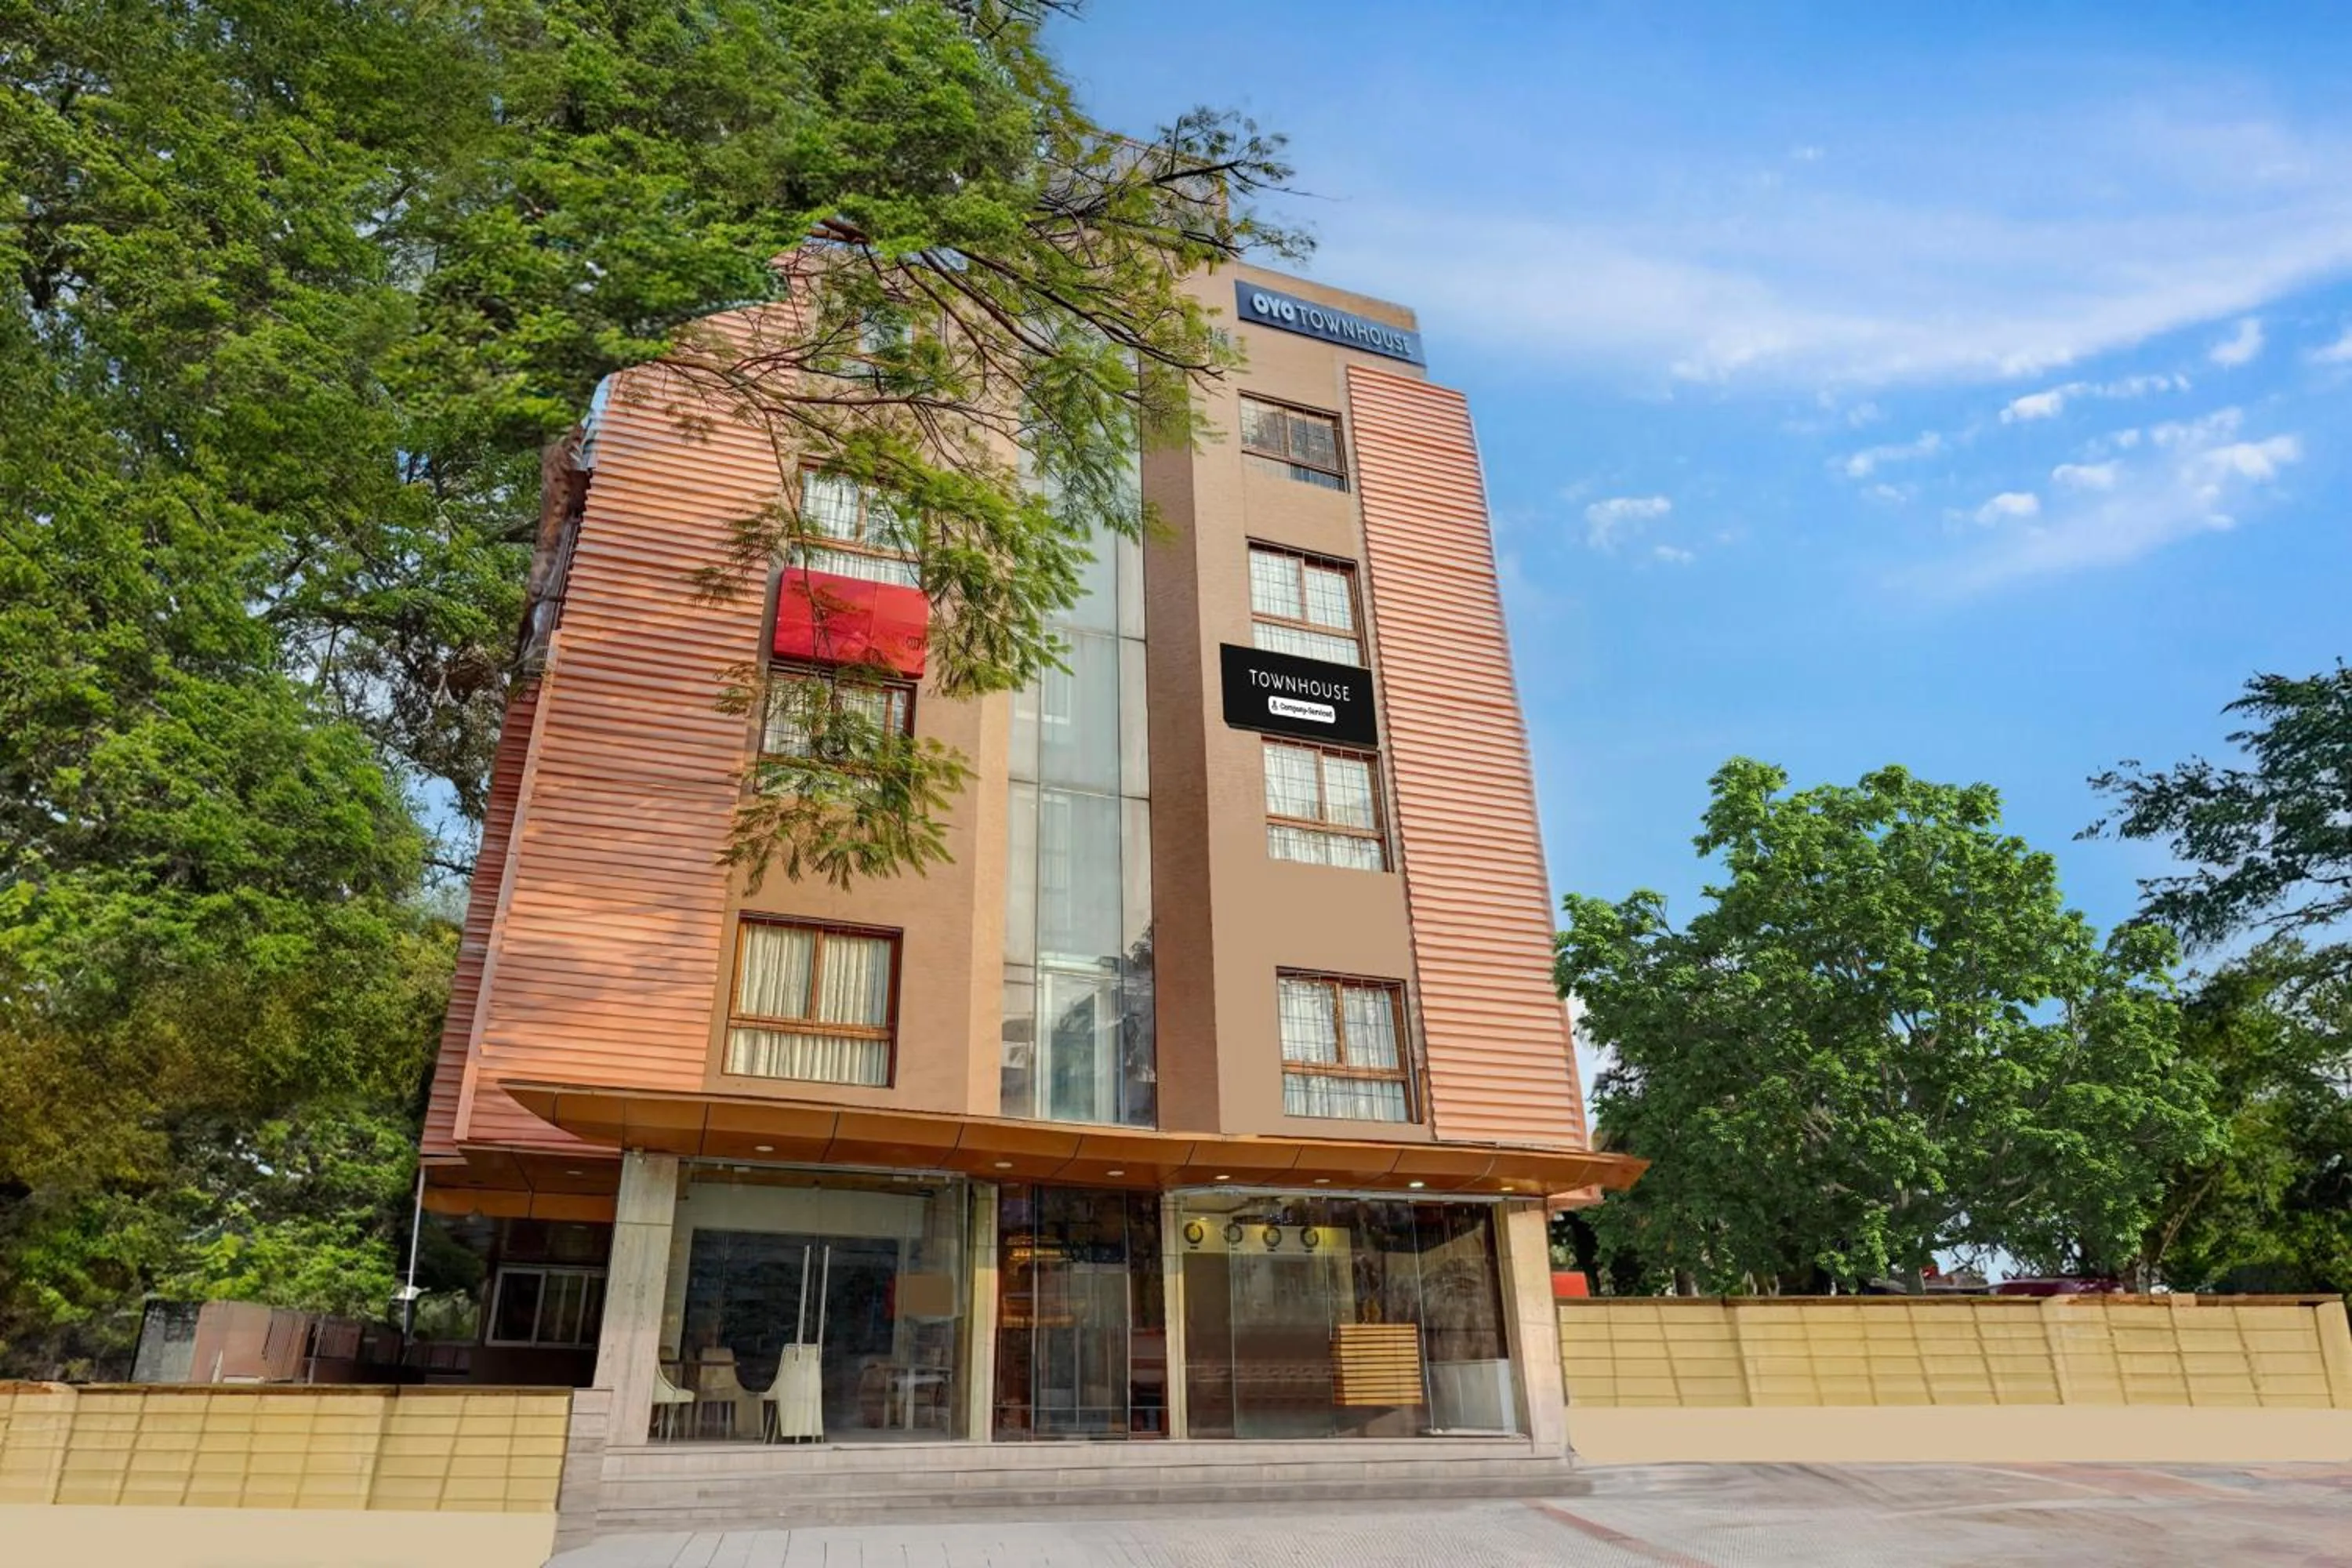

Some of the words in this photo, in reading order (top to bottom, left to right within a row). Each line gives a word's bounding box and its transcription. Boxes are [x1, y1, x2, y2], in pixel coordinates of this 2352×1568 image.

[1253, 292, 1295, 321] OYO
[1294, 304, 1413, 354] TOWNHOUSE
[1249, 669, 1351, 702] TOWNHOUSE
